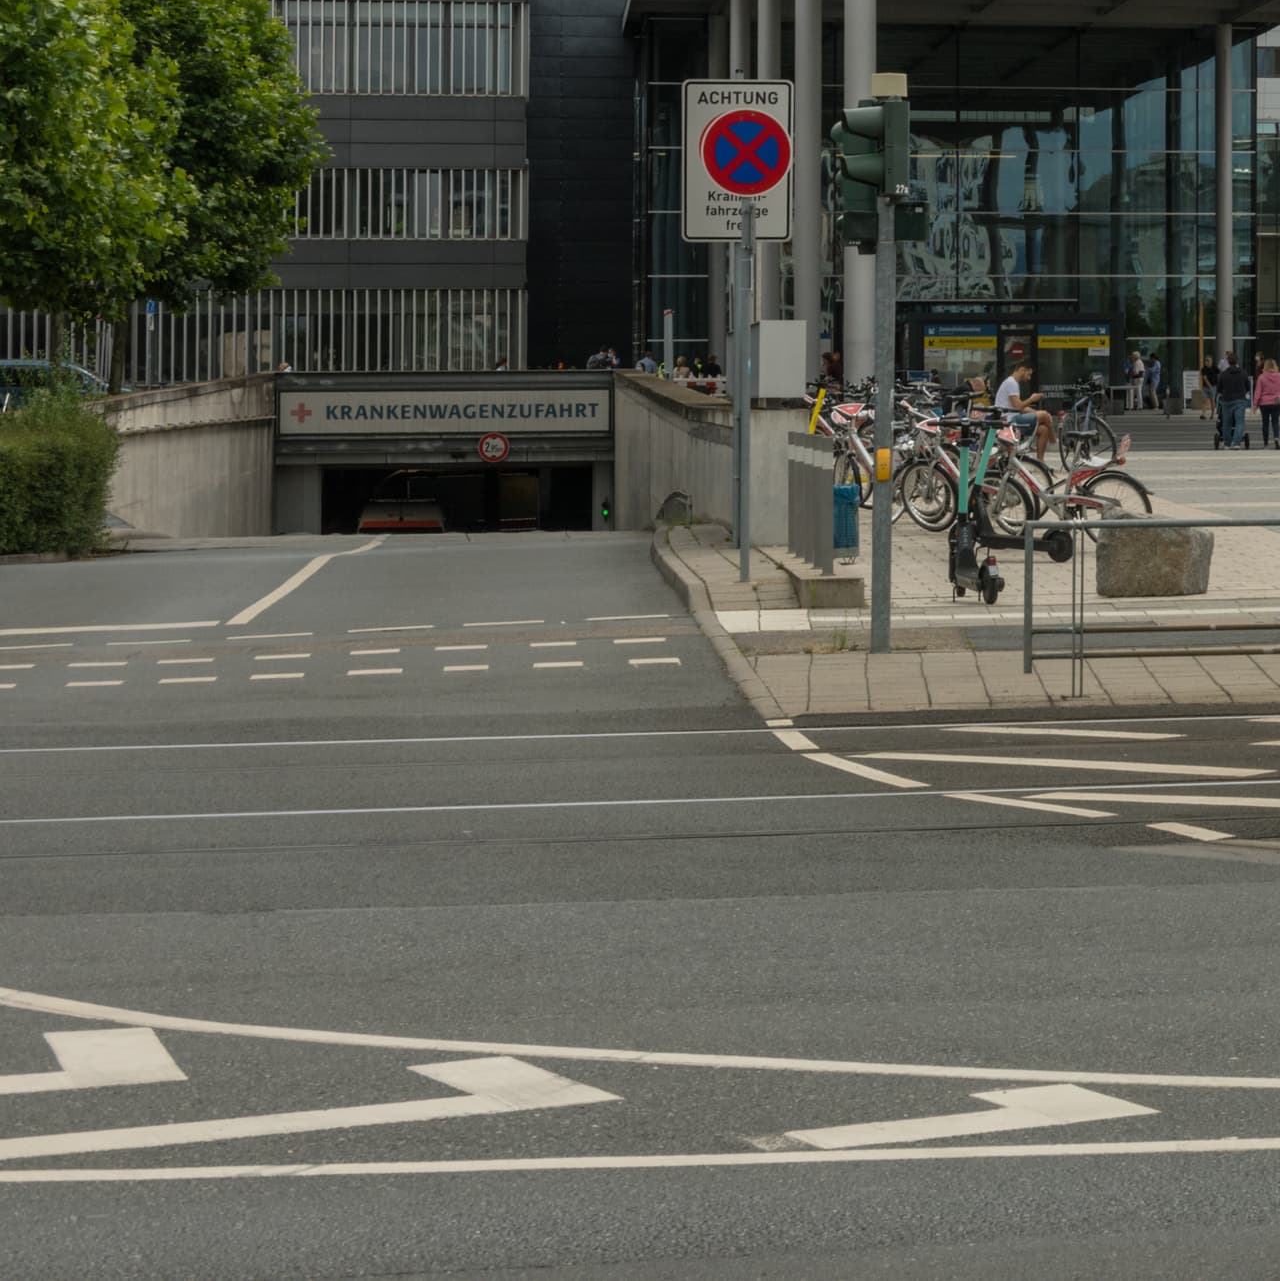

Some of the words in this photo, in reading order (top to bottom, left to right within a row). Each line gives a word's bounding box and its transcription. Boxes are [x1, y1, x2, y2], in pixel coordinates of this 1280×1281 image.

[697, 91, 779, 105] ACHTUNG
[726, 220, 743, 231] fre
[325, 402, 600, 421] KRANKENWAGENZUFAHRT
